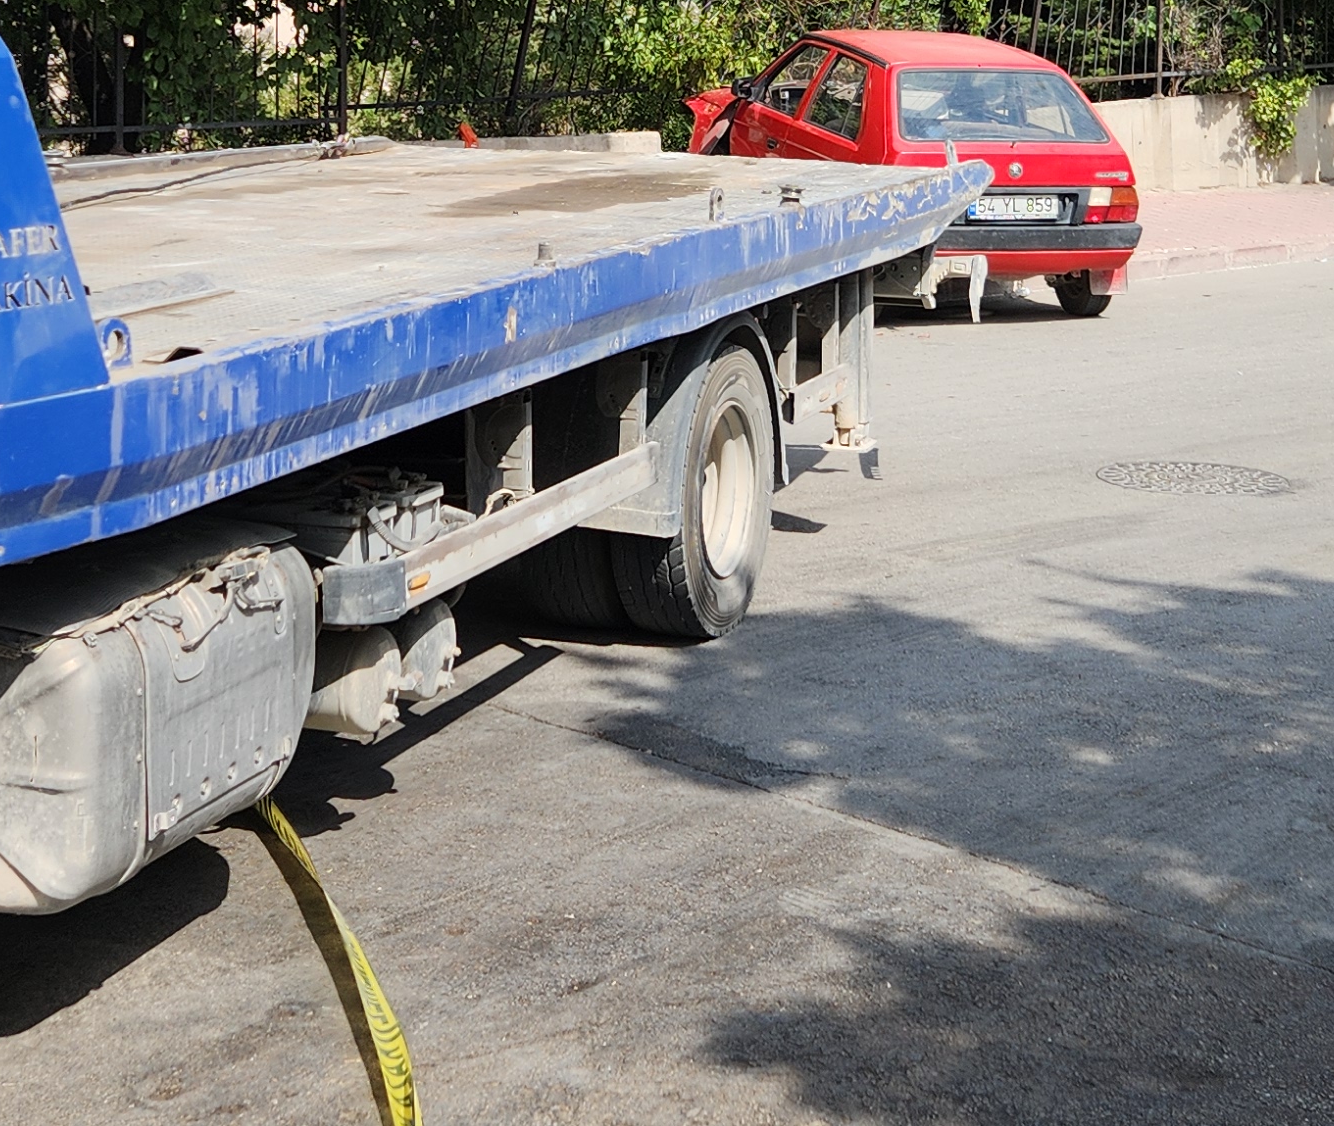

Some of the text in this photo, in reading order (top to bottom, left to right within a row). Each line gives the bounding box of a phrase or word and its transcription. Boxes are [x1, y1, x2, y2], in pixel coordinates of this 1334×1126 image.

[978, 197, 995, 213] 54
[1003, 197, 1021, 213] YL
[1026, 197, 1053, 213] 859
